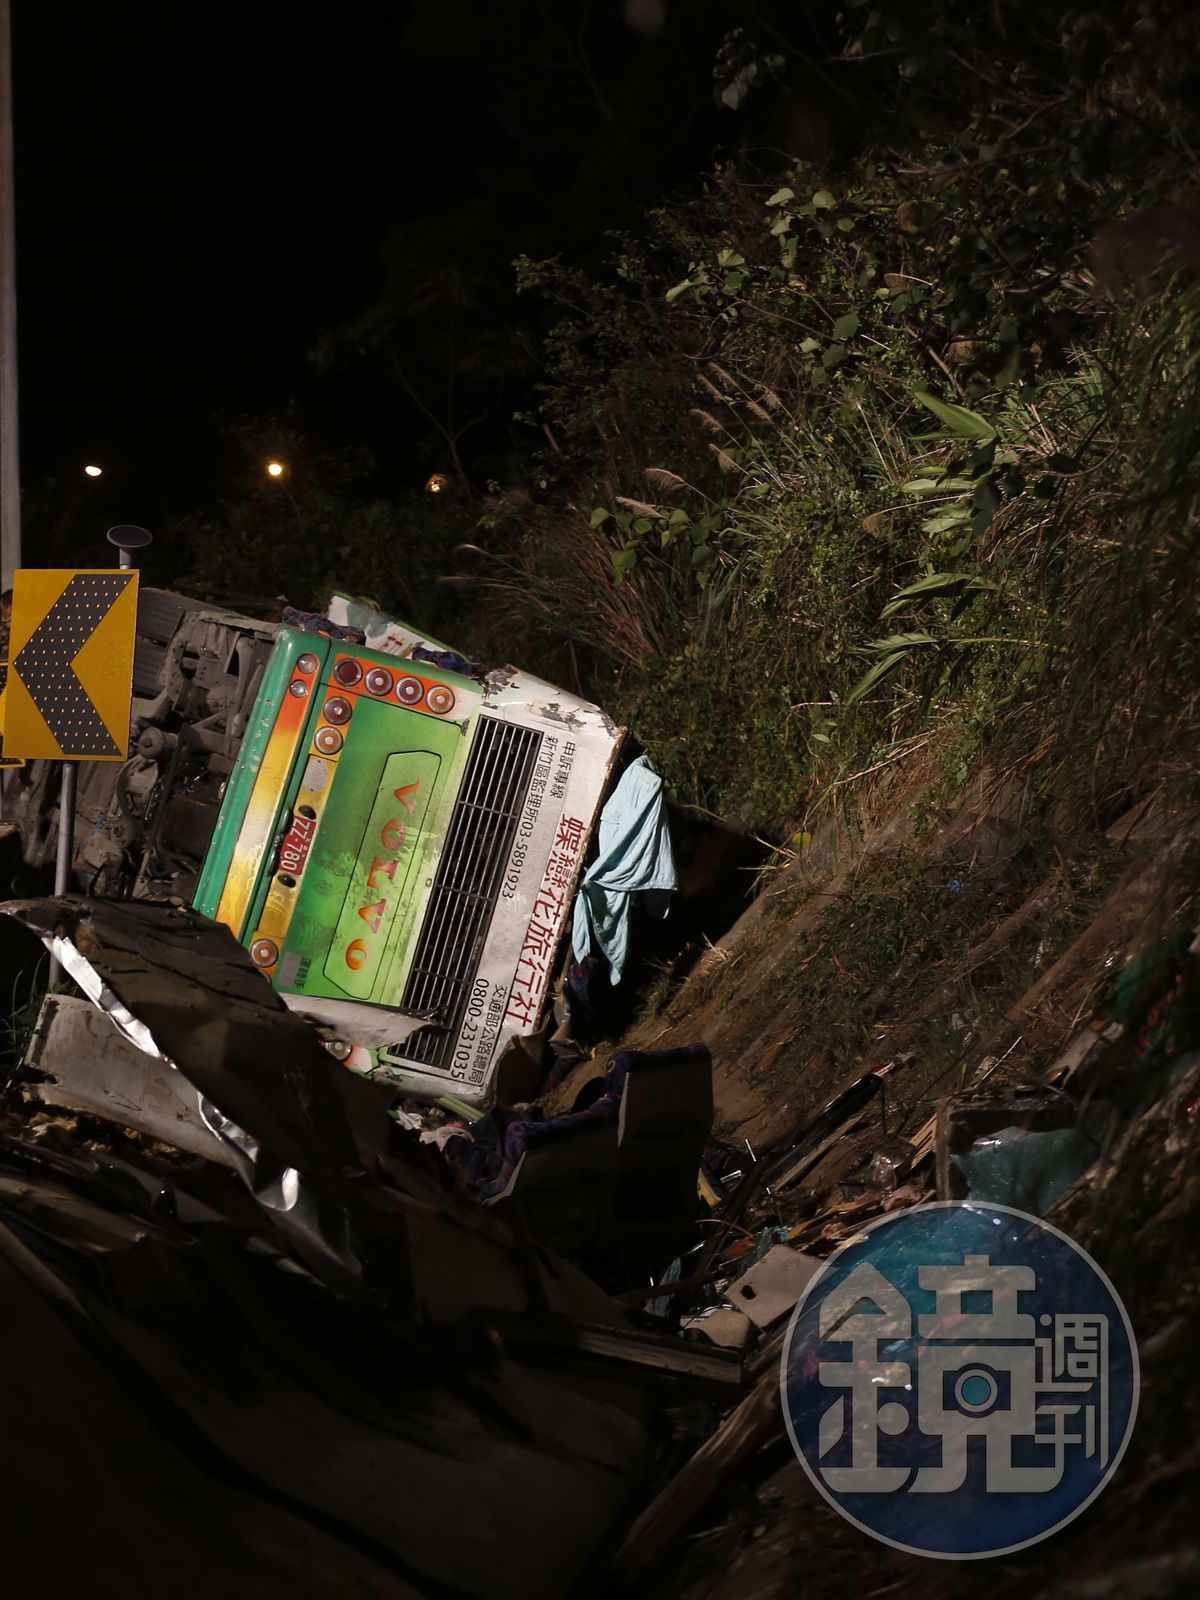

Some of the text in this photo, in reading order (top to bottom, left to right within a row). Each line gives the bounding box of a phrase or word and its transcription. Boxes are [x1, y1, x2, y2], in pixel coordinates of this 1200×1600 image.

[550, 741, 577, 799] 申訴專線
[345, 777, 422, 970] VOLVO
[506, 813, 586, 1028] 蝶戀花旅行社
[451, 978, 490, 1080] 0800-231035
[468, 983, 508, 1084] 交通部公路總局
